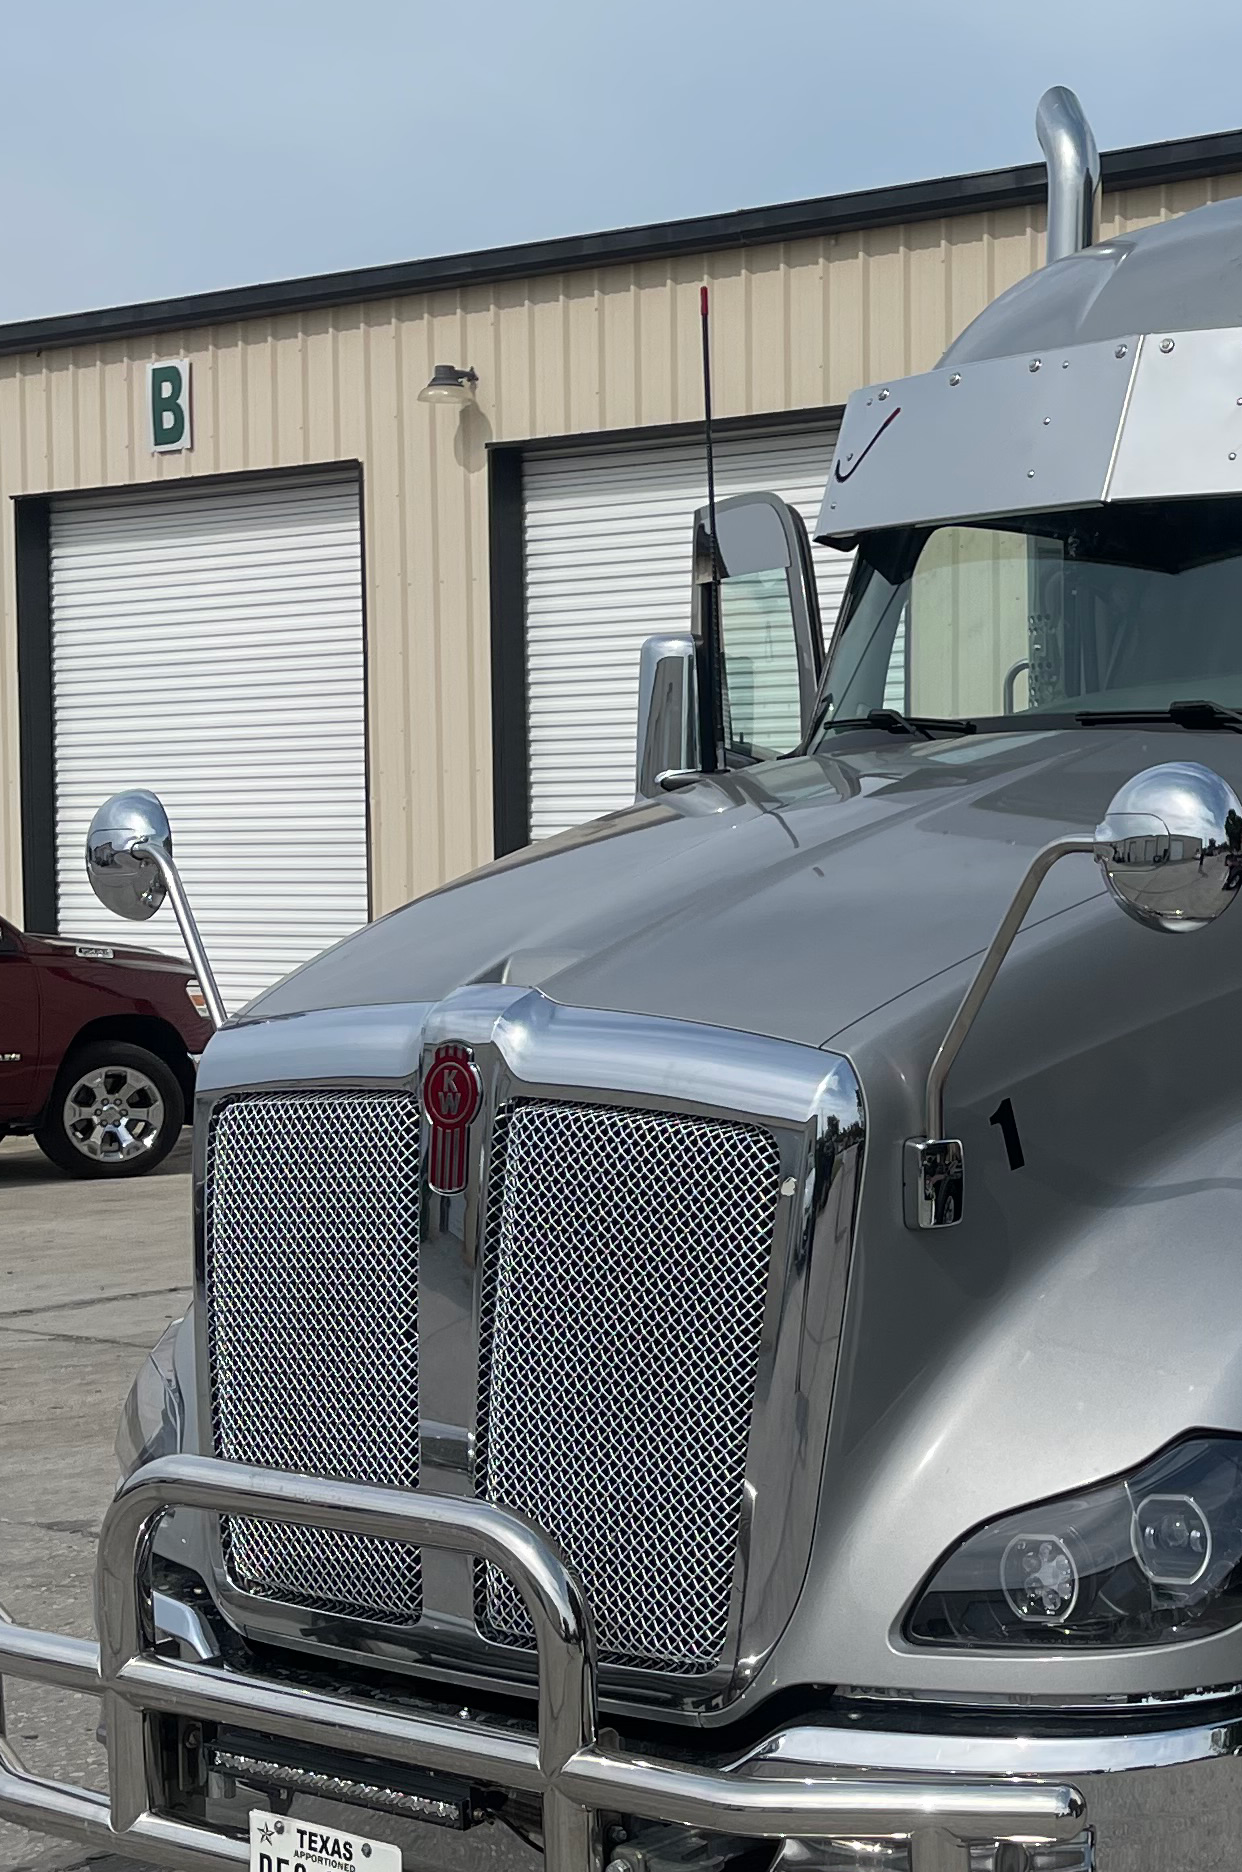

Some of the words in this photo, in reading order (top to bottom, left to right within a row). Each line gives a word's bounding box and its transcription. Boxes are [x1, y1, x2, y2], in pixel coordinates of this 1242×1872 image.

[151, 365, 185, 446] B
[989, 1097, 1025, 1171] 1
[293, 1849, 356, 1872] APPORTIONED
[296, 1828, 354, 1861] TEXAS
